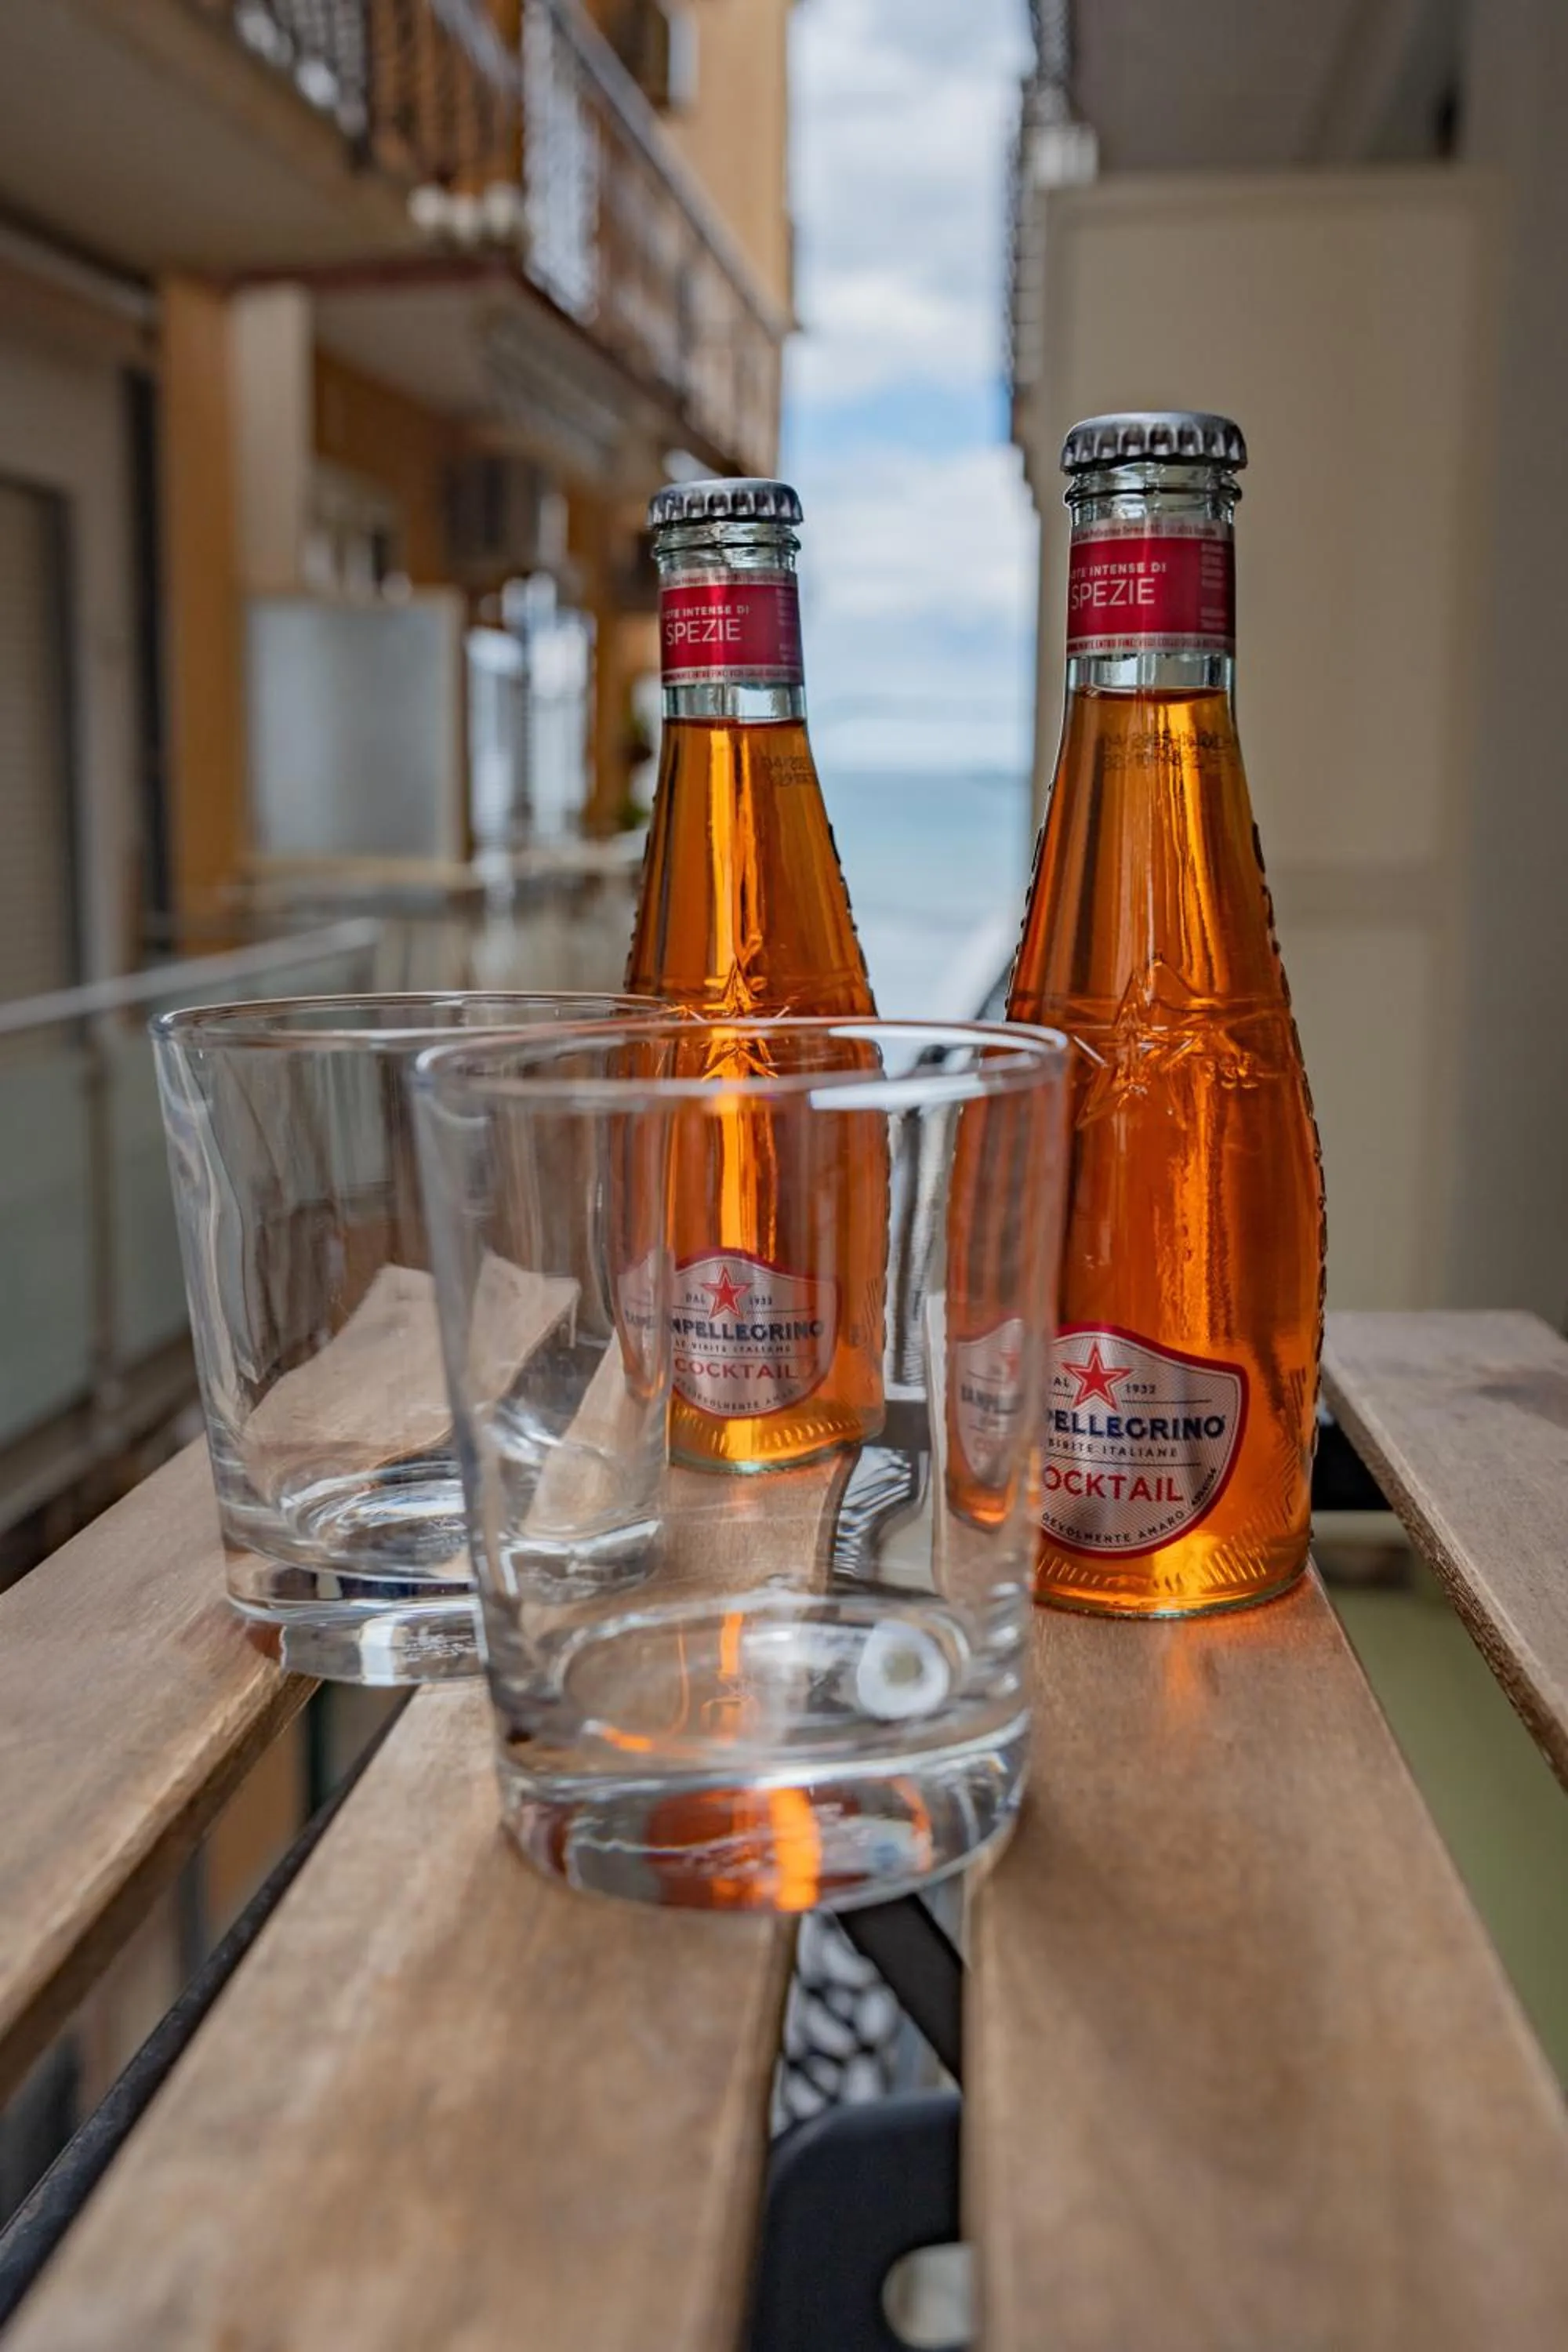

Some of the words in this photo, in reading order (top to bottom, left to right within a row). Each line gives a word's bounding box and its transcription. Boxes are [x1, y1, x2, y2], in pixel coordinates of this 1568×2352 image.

[1089, 562, 1145, 576] INTENSE
[1151, 561, 1167, 573] DI
[1071, 578, 1156, 610] SPEZIE
[683, 605, 732, 616] INTENSE
[736, 605, 750, 615] DI
[666, 619, 741, 645] SPEZIE
[674, 1358, 798, 1379] COCKTAIL
[1103, 1445, 1177, 1457] ITALIANE
[1138, 1510, 1185, 1539] AMARO
